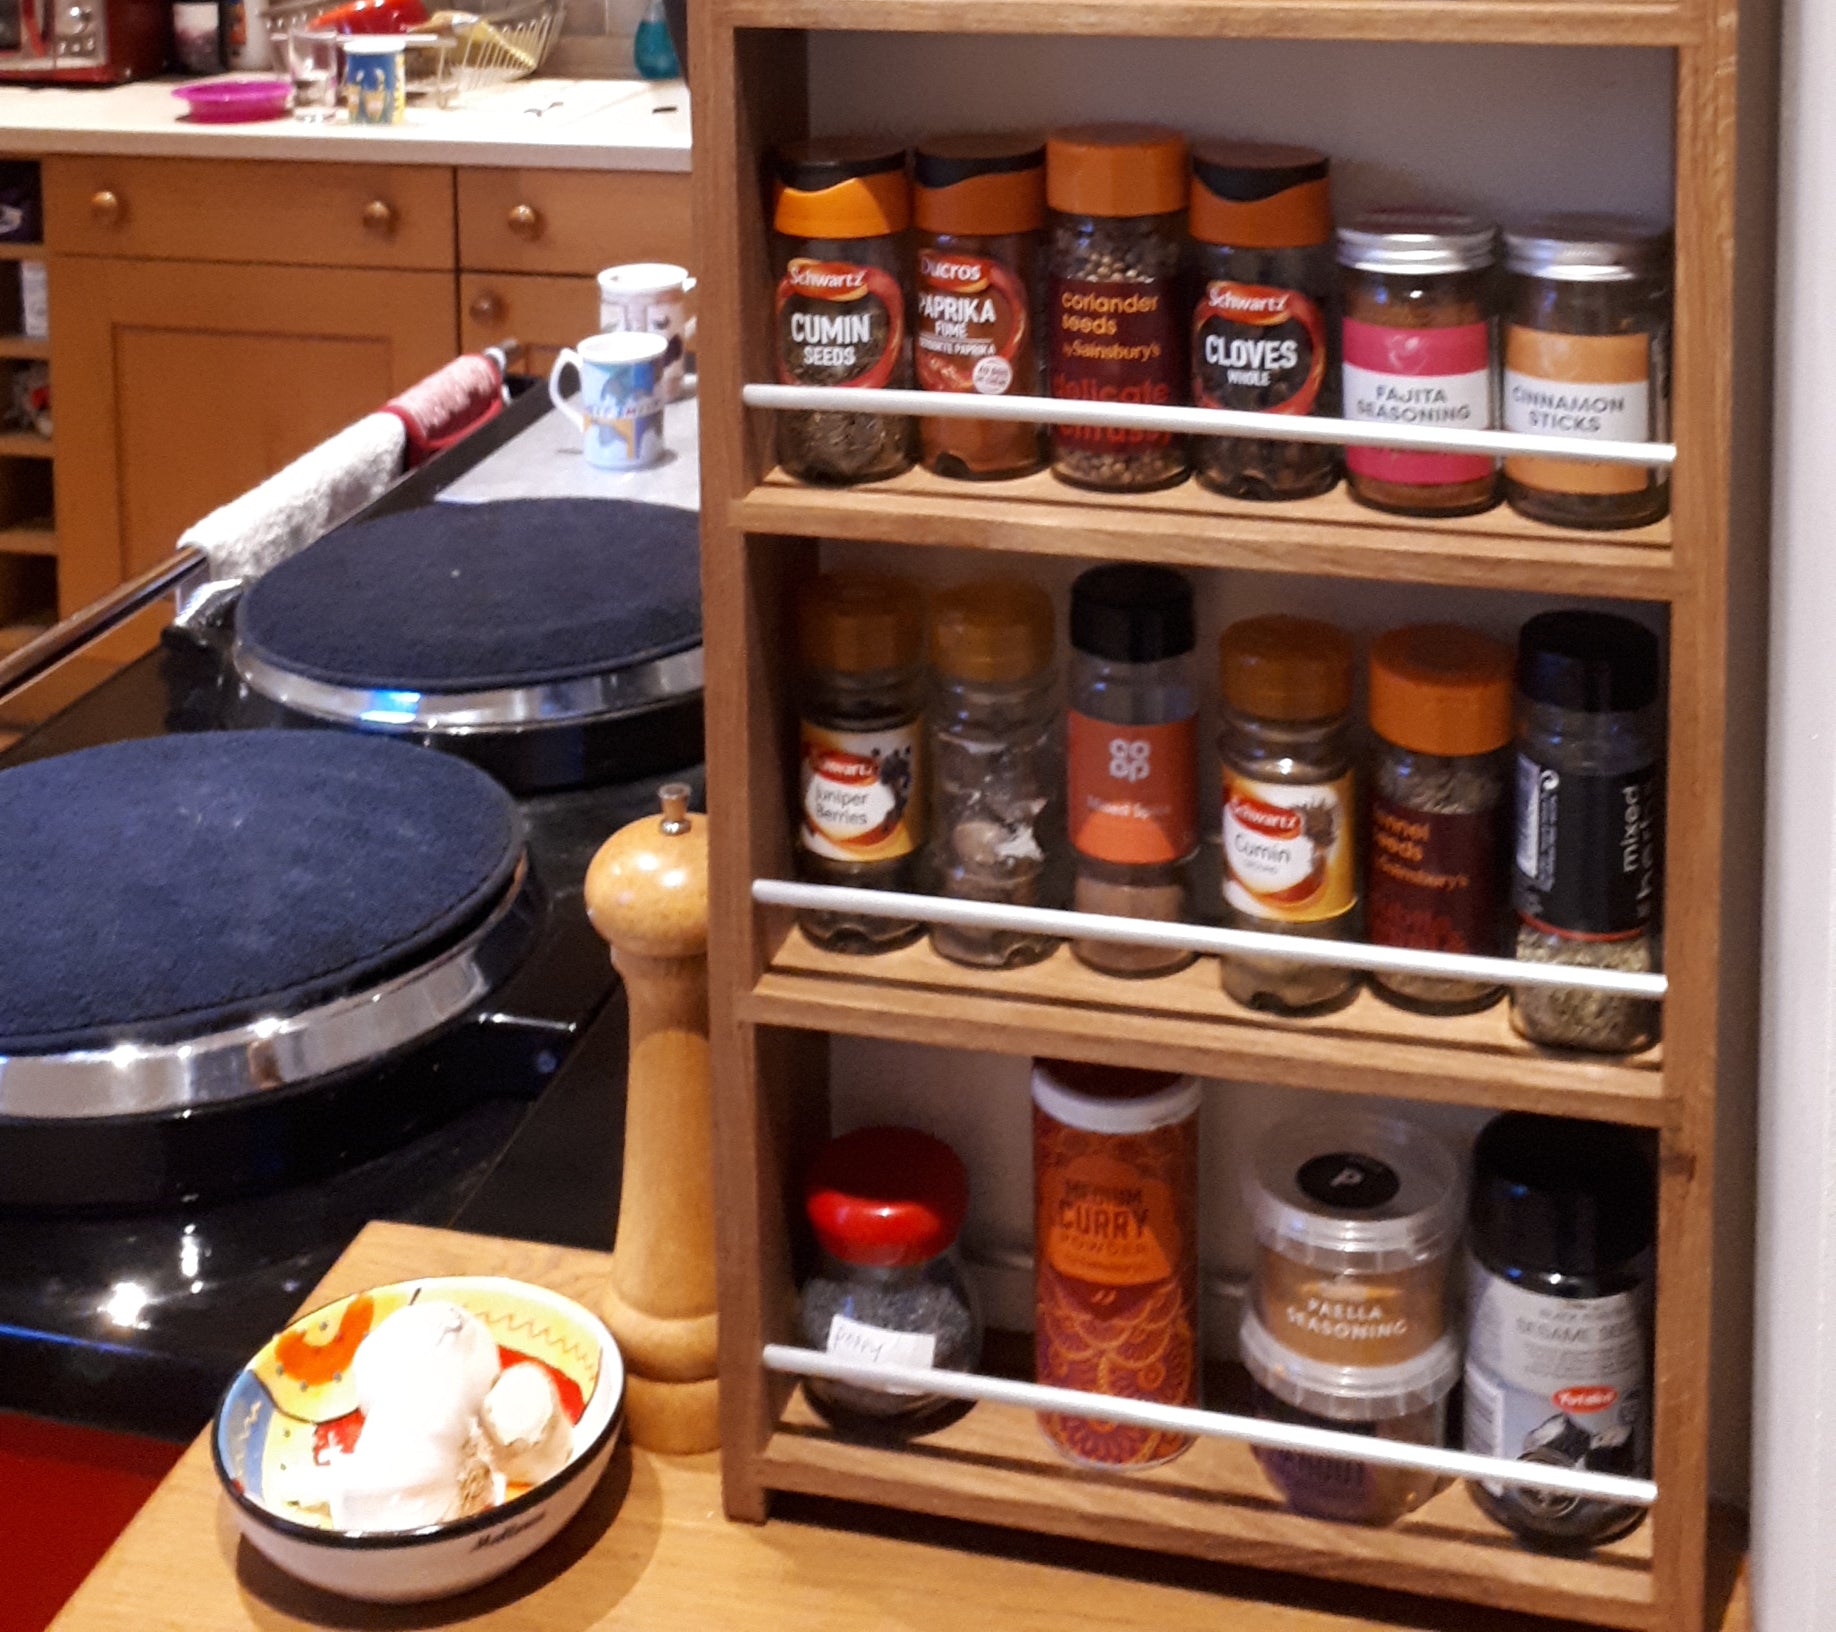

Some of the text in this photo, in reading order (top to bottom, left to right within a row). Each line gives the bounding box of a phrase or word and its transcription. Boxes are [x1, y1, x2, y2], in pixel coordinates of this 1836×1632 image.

[790, 266, 868, 288] Schwartz
[920, 255, 982, 281] Ducros
[919, 291, 996, 323] PAPRIKA
[1062, 292, 1160, 314] coriander
[1209, 287, 1290, 312] Schwartz
[791, 312, 872, 345] CUMIN
[1061, 313, 1118, 336] seeds
[803, 345, 857, 366] SEEDS
[1072, 339, 1162, 362] Sainsbury's
[1205, 334, 1299, 369] CLOVES
[1227, 369, 1272, 387] WHOLE
[1375, 384, 1447, 404] FAJITA
[1511, 386, 1626, 414] CINNAMON
[1356, 399, 1472, 423] SEASONING
[1528, 411, 1602, 433] STICKS
[815, 787, 869, 809] Juniper
[815, 804, 868, 825] Berries
[1230, 797, 1298, 830] Schwartz
[1621, 785, 1640, 873] mixed
[1235, 833, 1291, 864] Cumin
[1058, 1199, 1149, 1239] CURRY
[1306, 1296, 1383, 1321] PAELLA
[1286, 1305, 1408, 1341] SEASONING
